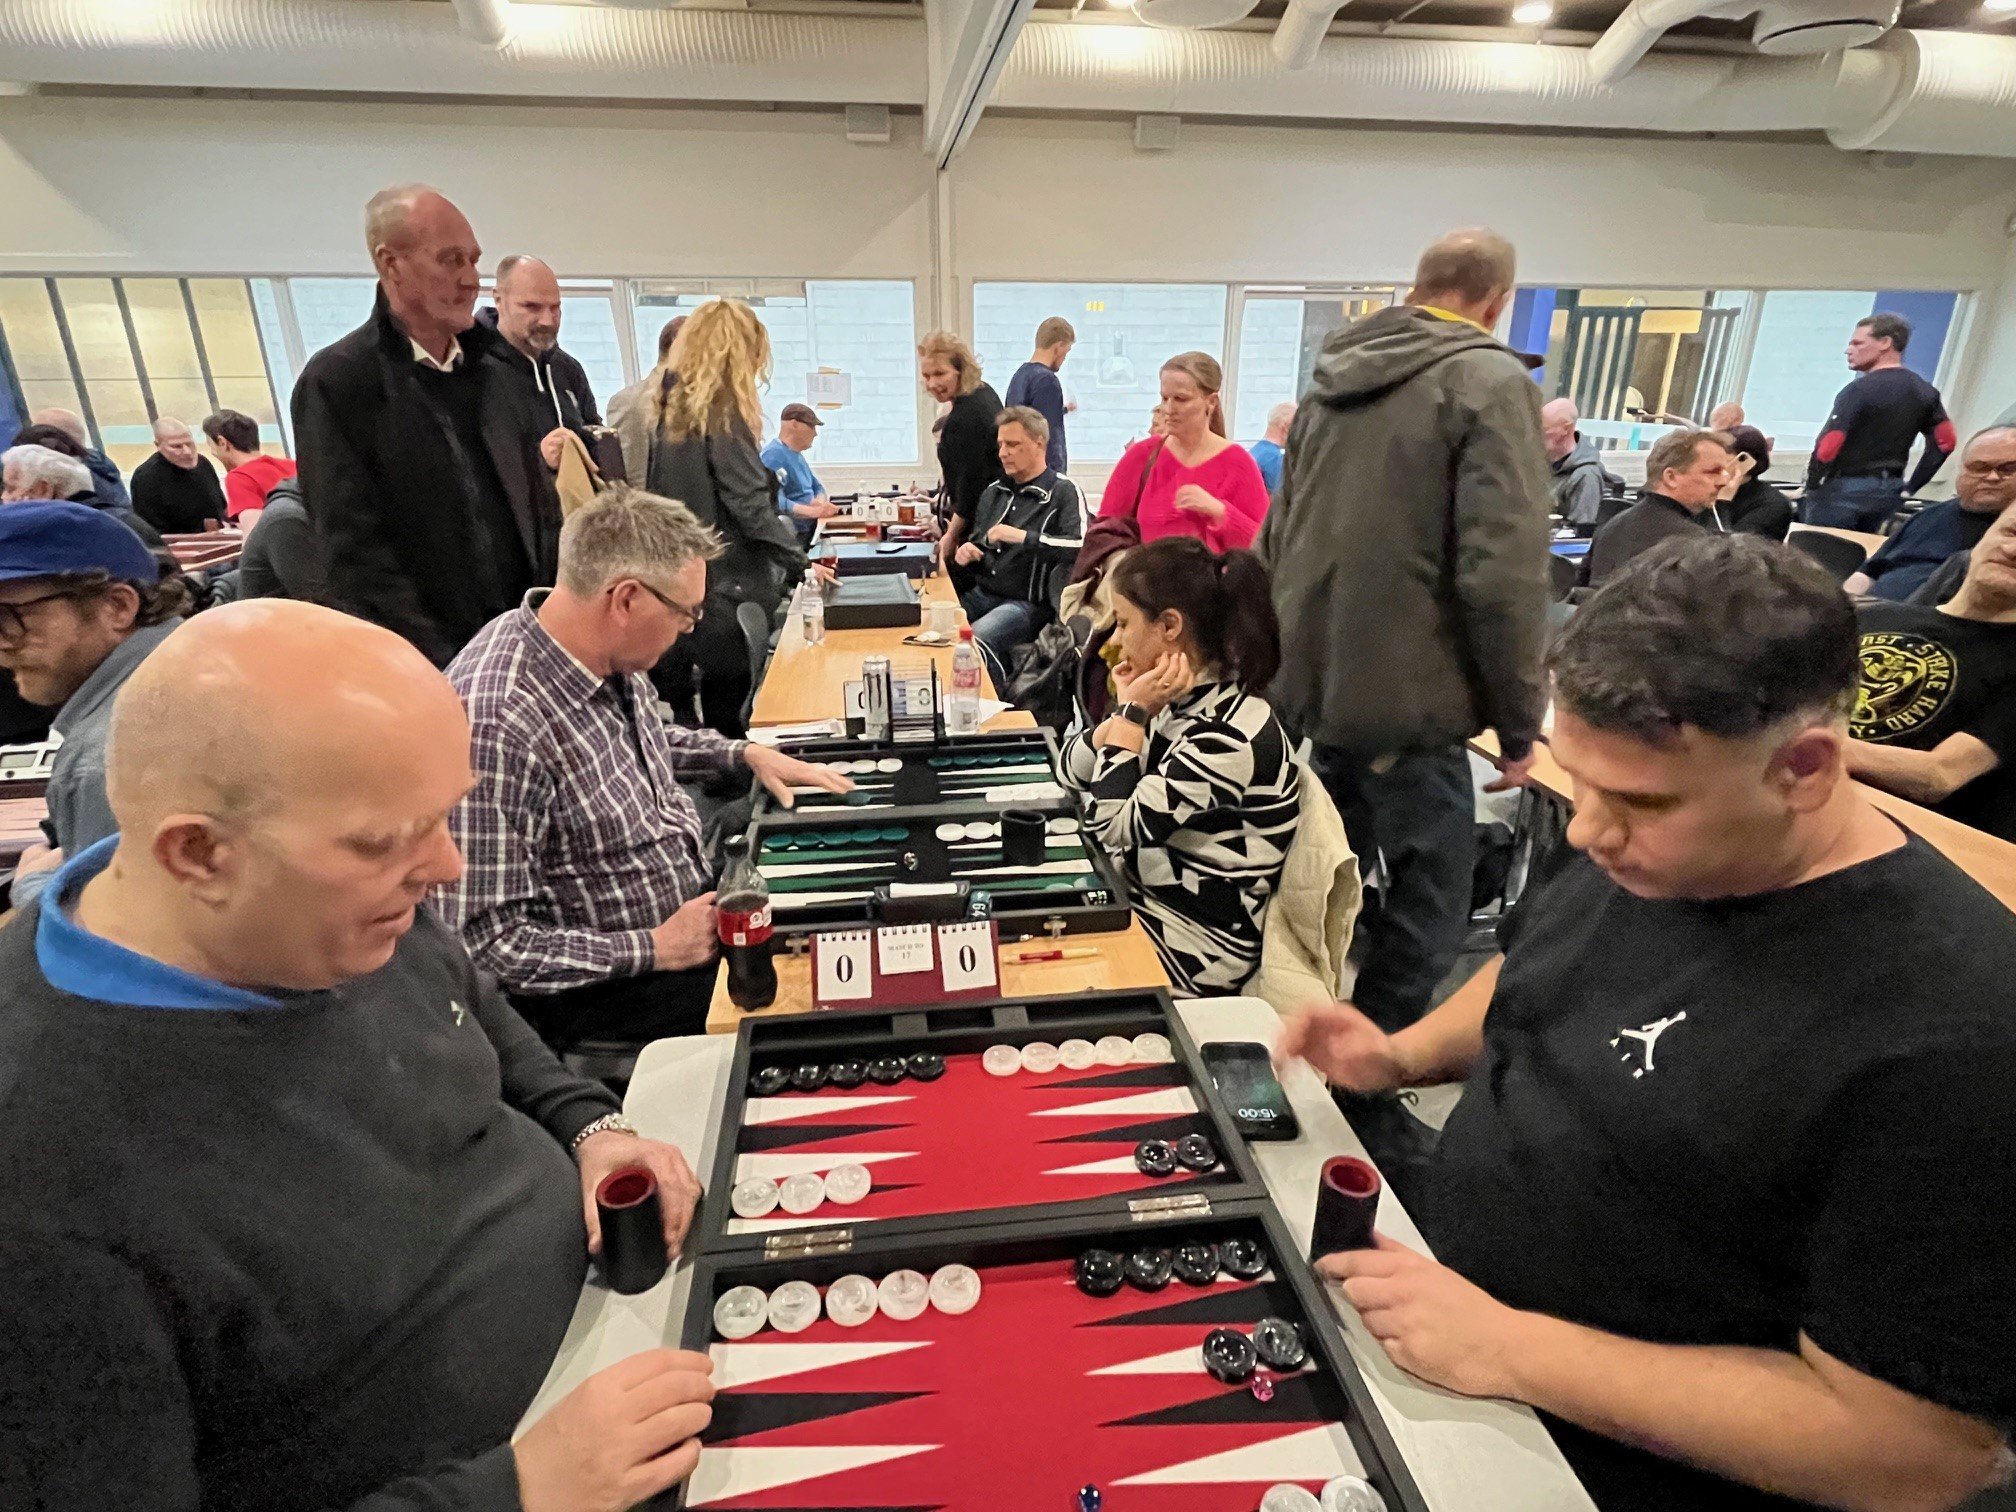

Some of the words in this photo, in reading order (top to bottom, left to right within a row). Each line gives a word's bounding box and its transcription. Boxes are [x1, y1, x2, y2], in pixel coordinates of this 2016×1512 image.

[1861, 635, 1904, 646] RST
[1915, 643, 1950, 691] STRIKE
[1885, 696, 1938, 731] HARD
[836, 954, 854, 983] 0
[959, 944, 977, 973] 0
[1238, 1108, 1278, 1119] 15:00
